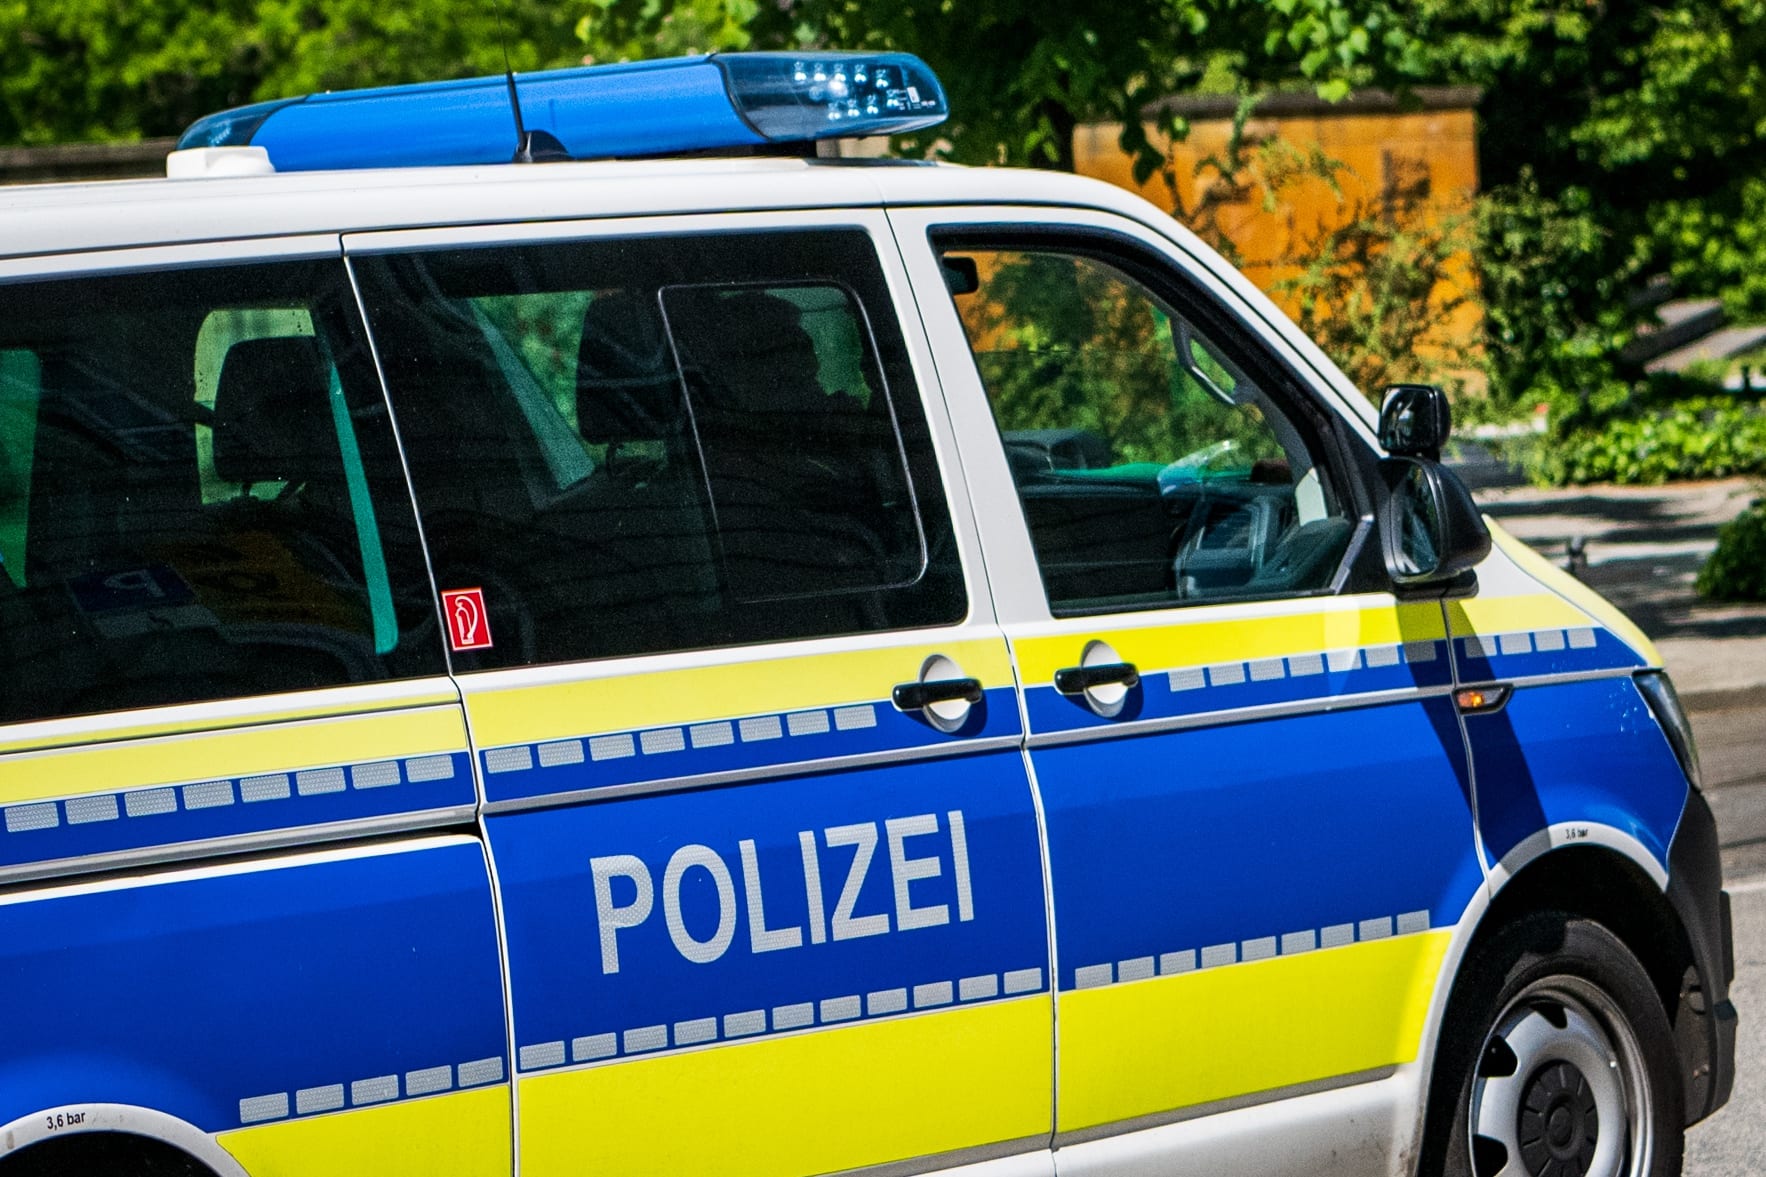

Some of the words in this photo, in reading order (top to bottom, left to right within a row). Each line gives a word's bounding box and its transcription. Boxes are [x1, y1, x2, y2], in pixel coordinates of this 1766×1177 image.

[590, 810, 974, 974] POLIZEI
[46, 1114, 63, 1131] 3,6
[66, 1112, 86, 1125] bar
